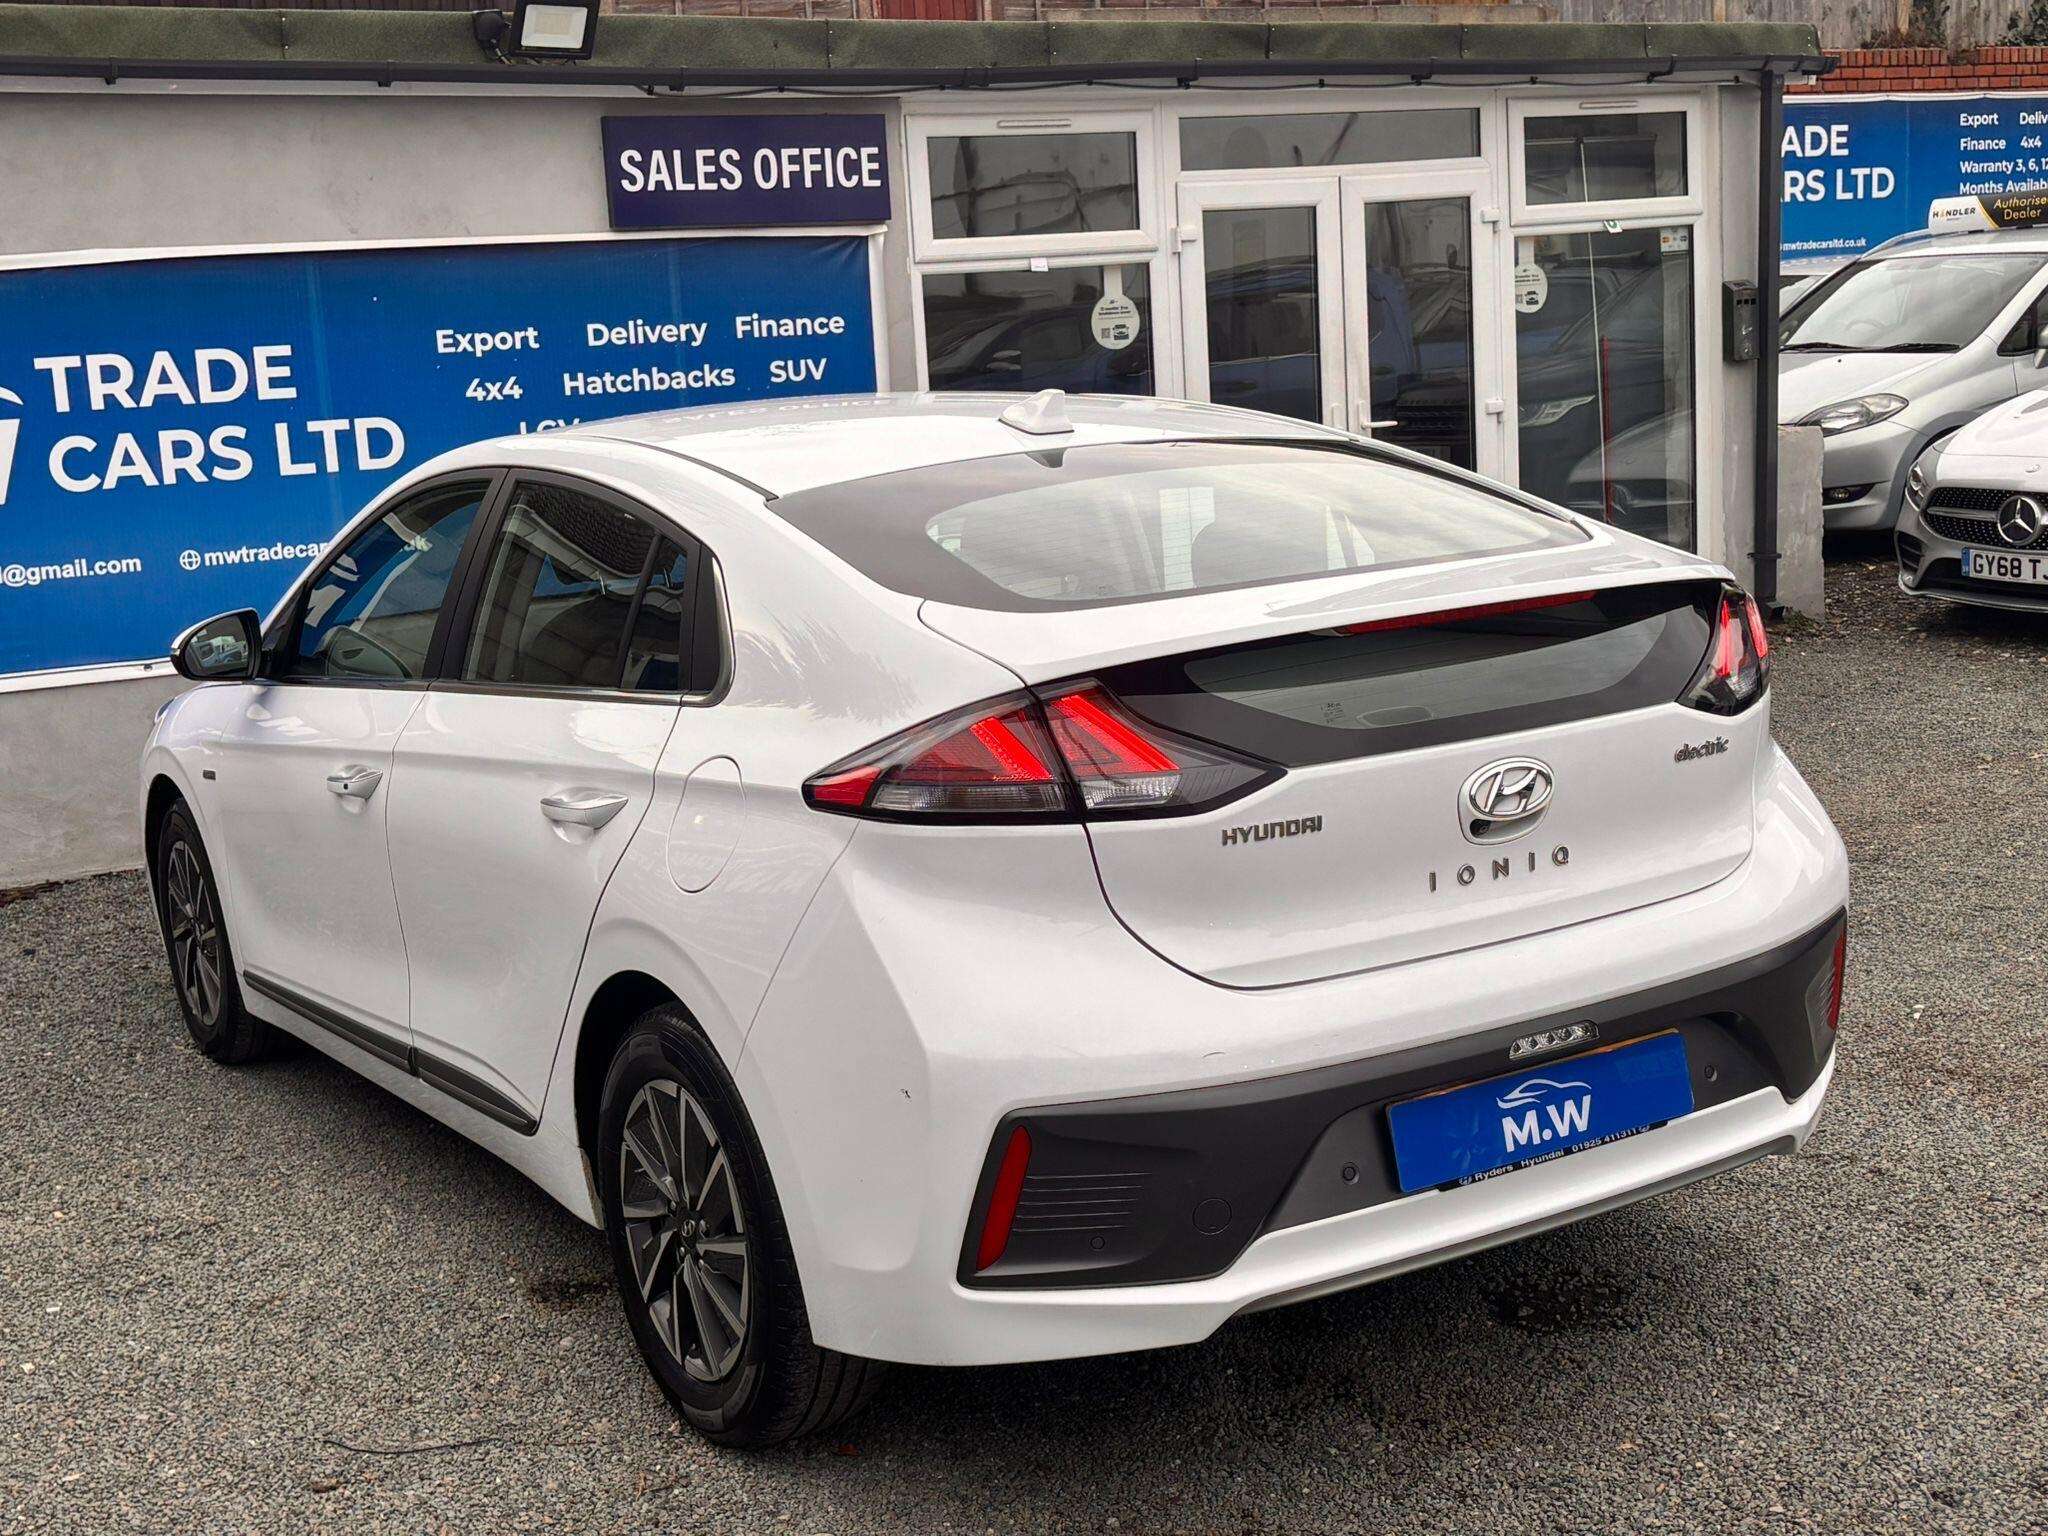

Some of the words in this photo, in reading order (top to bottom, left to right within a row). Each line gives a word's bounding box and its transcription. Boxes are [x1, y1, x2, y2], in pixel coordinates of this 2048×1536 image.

[1960, 113, 1999, 128] Export
[1781, 125, 1850, 158] ADE
[1960, 137, 2006, 151] Finance
[2020, 136, 2042, 149] 4x4
[620, 148, 743, 192] SALES
[753, 147, 882, 190] OFFICE
[1960, 161, 2014, 174] Warranty
[2015, 159, 2026, 173] 3,
[2028, 158, 2039, 173] 6,
[1780, 170, 1825, 202] RS
[1836, 167, 1896, 200] LTD
[1960, 180, 2003, 194] Months
[1993, 195, 2048, 209] Authorise
[2004, 207, 2041, 220] Dealer
[436, 327, 540, 356] Export
[587, 318, 708, 347] Delivery
[736, 313, 845, 340] Finance
[34, 344, 298, 412] TRADE
[465, 376, 523, 401] 4x4
[563, 363, 736, 396] Hatchbacks
[769, 358, 828, 384] SUV
[48, 425, 254, 493] CARS
[275, 417, 405, 476] LTD
[1973, 554, 2022, 578] GY68
[1674, 736, 1730, 763] electric
[1222, 815, 1323, 846] HYUNDAI
[1428, 844, 1571, 892] IONIQ
[1501, 1095, 1591, 1153] M.W
[1475, 1164, 1514, 1182] Ryders
[1520, 1149, 1564, 1168] Hyundai
[1571, 1137, 1602, 1153] 01925
[1604, 1127, 1638, 1143] 411311
